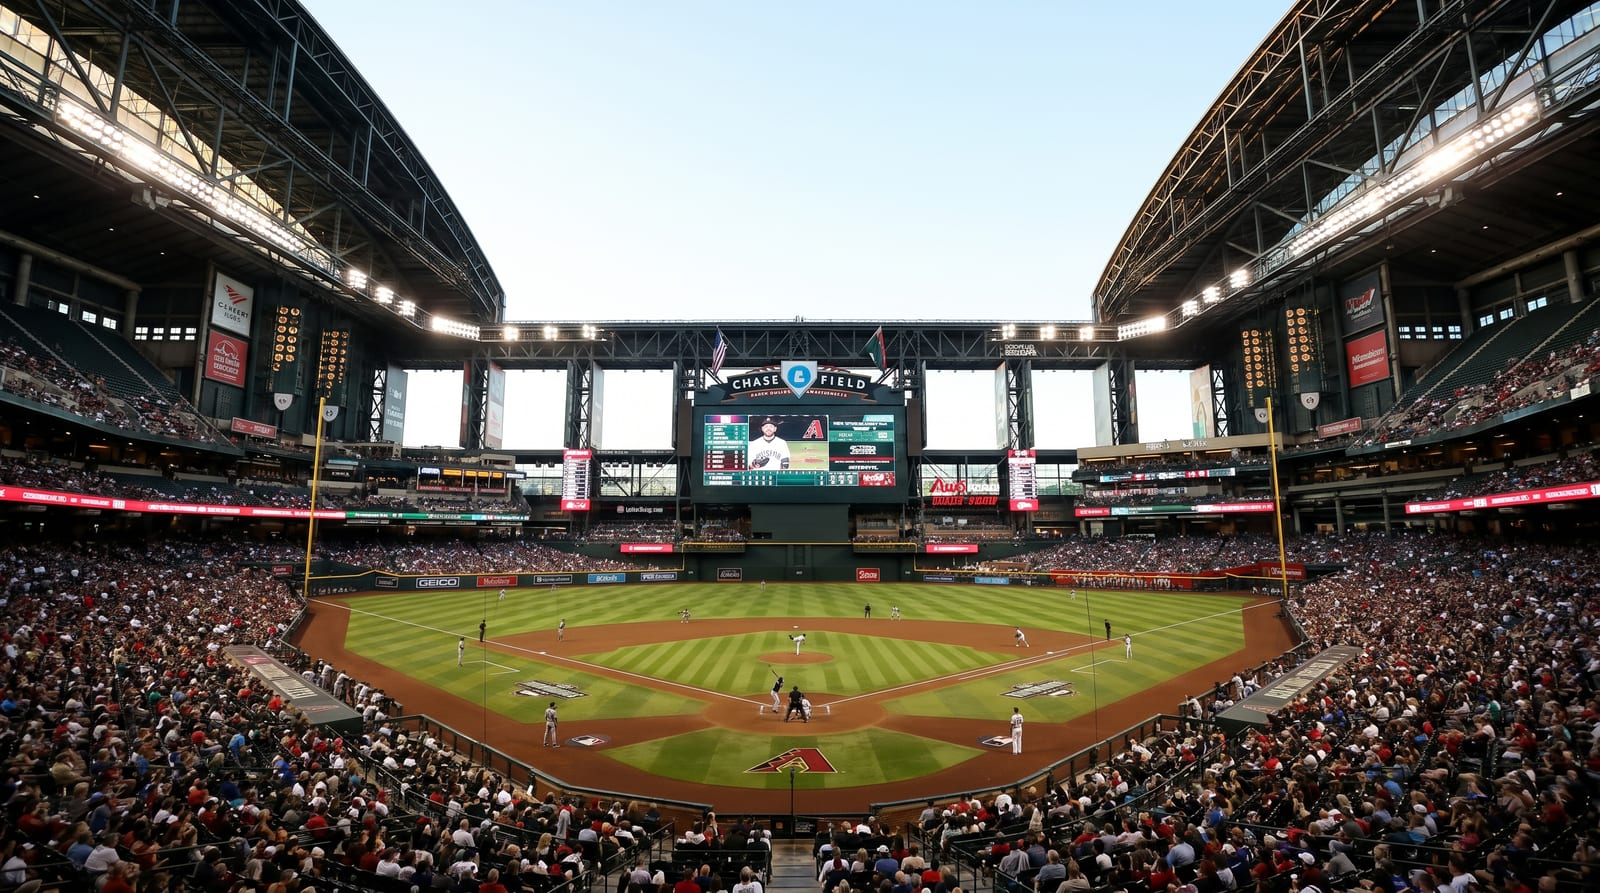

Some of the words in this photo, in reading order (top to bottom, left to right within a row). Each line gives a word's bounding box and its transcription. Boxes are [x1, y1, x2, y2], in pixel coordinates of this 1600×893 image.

[732, 375, 779, 390] CHASE
[820, 375, 866, 390] FIELD
[419, 578, 457, 587] GEICO
